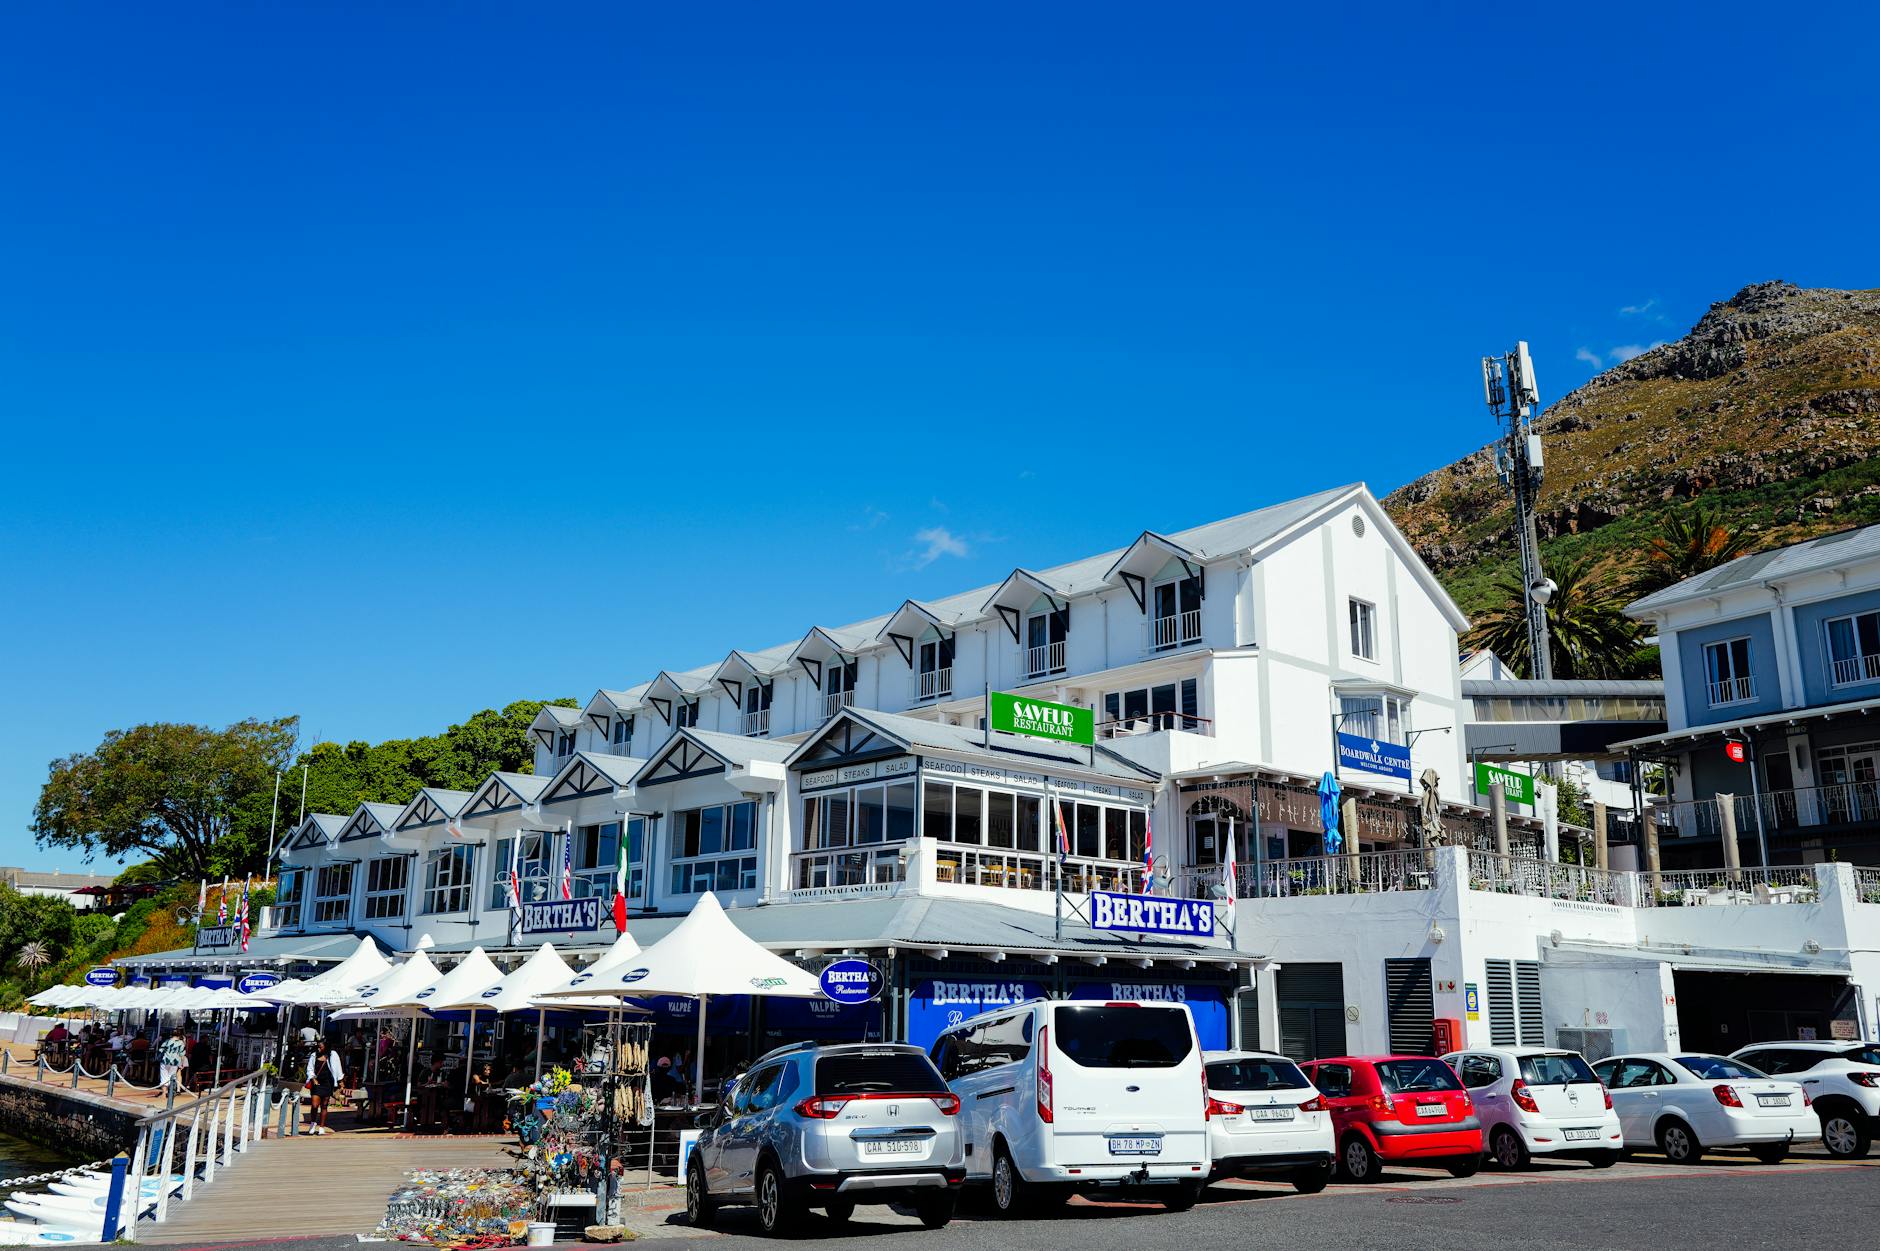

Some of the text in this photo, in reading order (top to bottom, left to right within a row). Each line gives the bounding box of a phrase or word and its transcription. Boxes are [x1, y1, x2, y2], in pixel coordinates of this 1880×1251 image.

[1013, 701, 1073, 727] SAVEUR
[1013, 717, 1073, 737] RESTAURANT
[1340, 744, 1410, 770] BOARDWALK CENTRE
[1360, 761, 1378, 770] WELCOME
[805, 760, 909, 786] SEAFOOD STEAKS SALAD
[923, 759, 1145, 800] SEAFOOD STEAKS SALAD SEAFOOD STEAKS SALAD
[523, 901, 597, 933] BERTHA'S
[1094, 893, 1212, 933] BERTHA'S
[198, 928, 230, 947] BERTHA'S
[245, 979, 280, 987] BERTHA'S
[828, 971, 877, 983] BERTHA'S
[834, 984, 869, 994] Restaurant
[932, 980, 1025, 1006] BERTHA'S
[1111, 982, 1185, 1001] BERTHA'S
[668, 1000, 692, 1014] VALPRÉ
[867, 1142, 882, 1153] CAA
[1112, 1140, 1121, 1149] BH
[1124, 1140, 1133, 1149] 78
[1150, 1140, 1160, 1149] ZN
